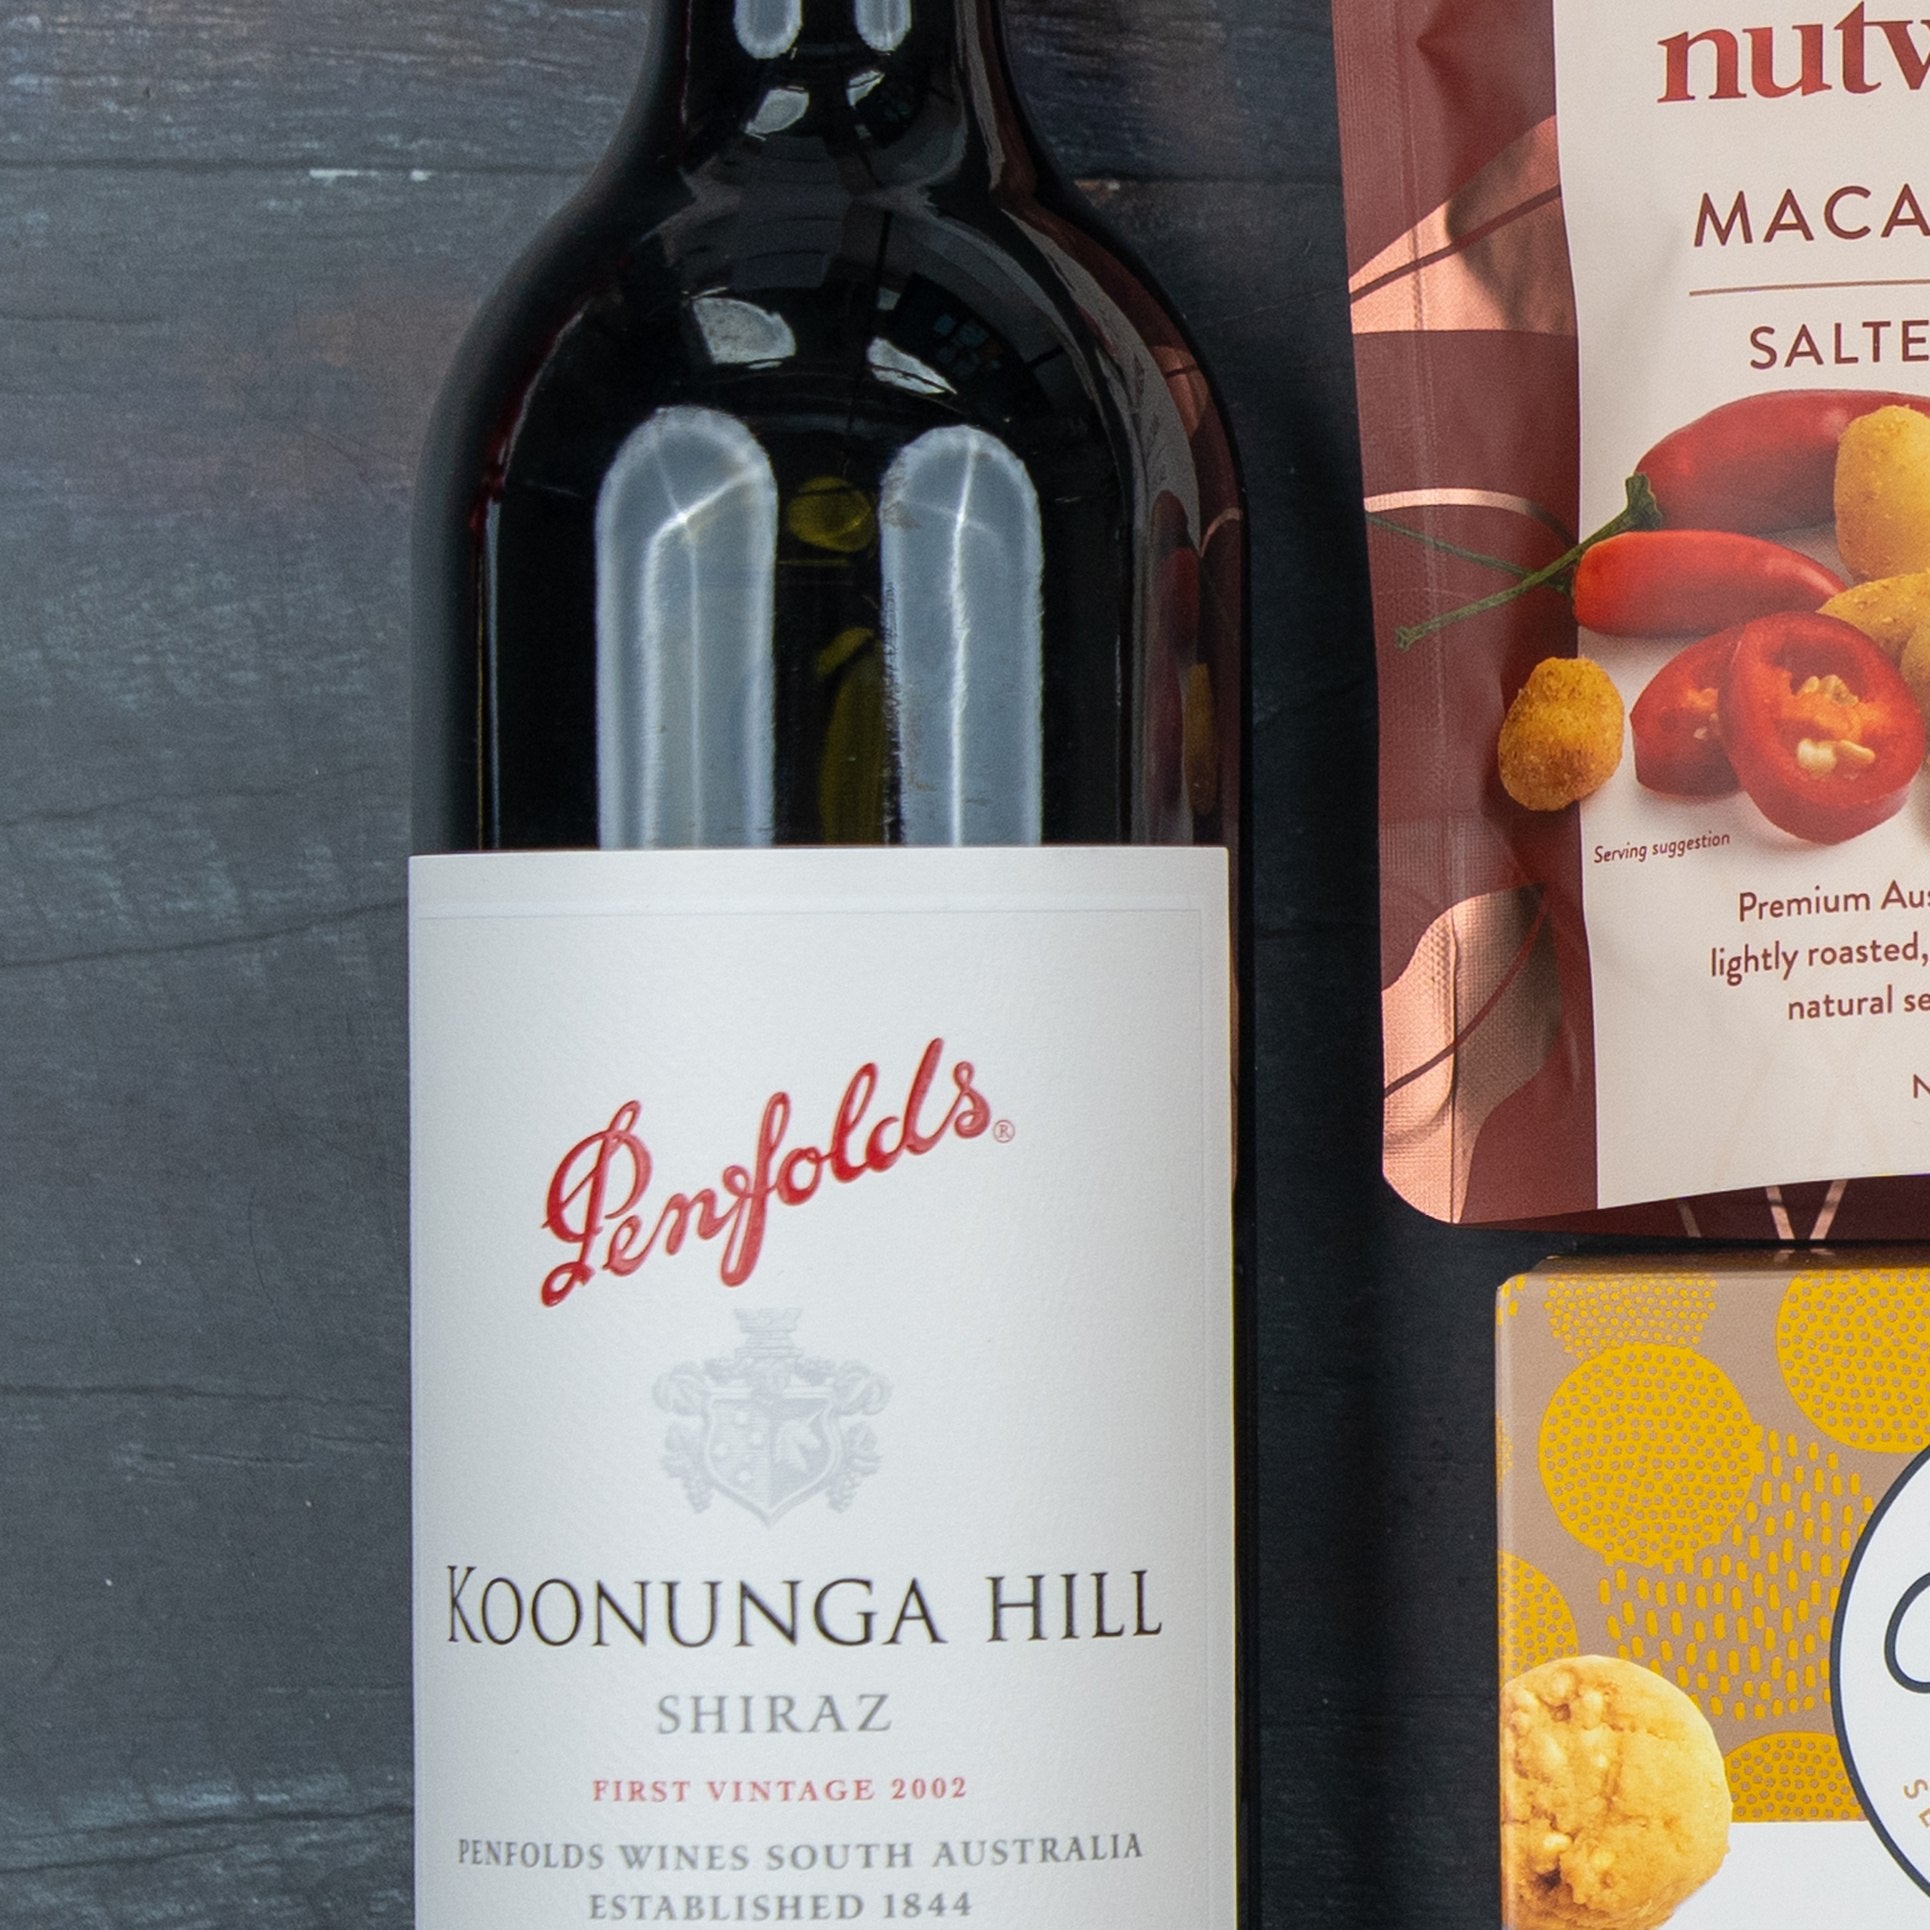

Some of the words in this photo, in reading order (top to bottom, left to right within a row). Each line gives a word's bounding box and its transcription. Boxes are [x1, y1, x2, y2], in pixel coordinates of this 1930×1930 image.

[1693, 183, 1930, 248] MACA
[1749, 319, 1930, 370] SALTE
[1593, 841, 1648, 864] Serving
[1652, 829, 1731, 859] suggestion
[1739, 884, 1871, 923] Premium
[1880, 879, 1930, 910] Au
[1711, 940, 1799, 987] lightly
[1808, 930, 1929, 967] roasted,
[1788, 983, 1893, 1021] natural
[446, 1564, 947, 1648] KOONUNGA
[986, 1569, 1163, 1642] HILL
[658, 1693, 892, 1735] SHIRAZ
[592, 1779, 690, 1803] FIRST
[707, 1779, 875, 1802] VINTAGE
[891, 1776, 966, 1800] 2002
[458, 1837, 604, 1870] PENFOLDS
[617, 1844, 750, 1871] WINES
[766, 1842, 912, 1871] SOUTH
[933, 1832, 1144, 1867] AUSTRALIA
[589, 1893, 865, 1921] ESTABLISHED
[884, 1891, 972, 1919] 1844
